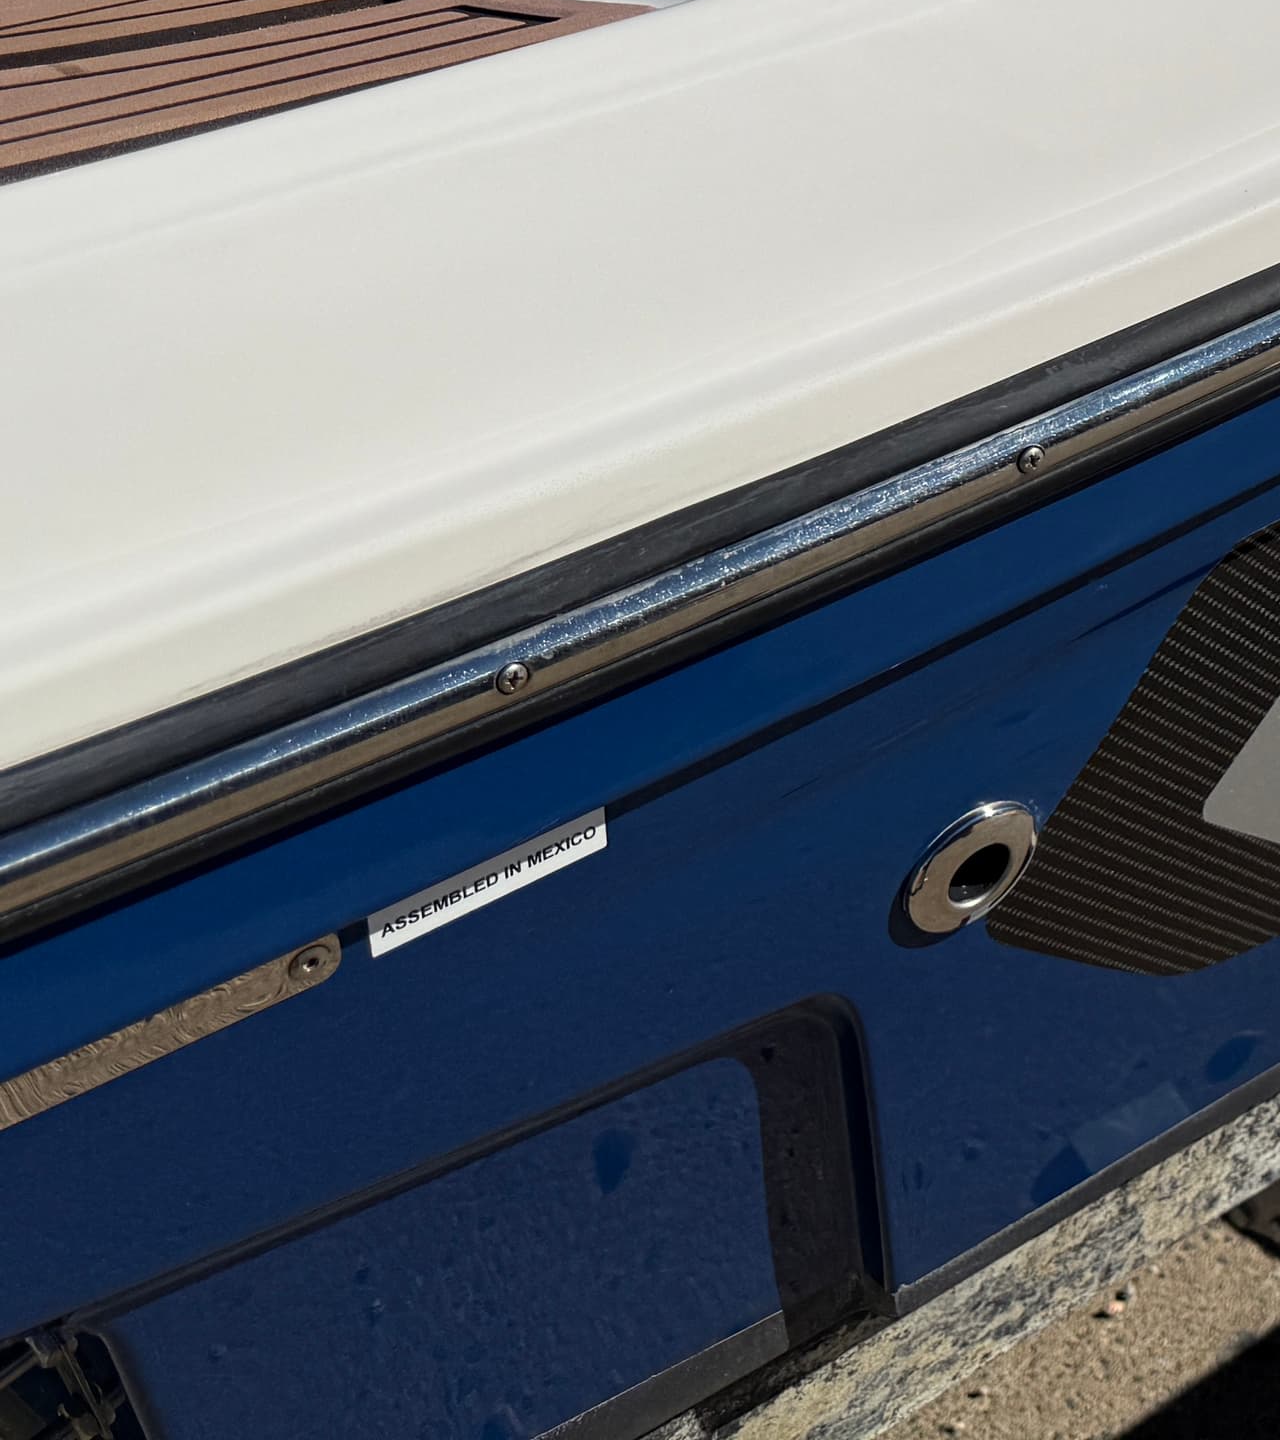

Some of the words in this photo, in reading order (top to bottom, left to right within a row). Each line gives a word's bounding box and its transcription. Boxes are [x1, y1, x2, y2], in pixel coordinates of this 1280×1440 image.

[381, 871, 499, 938] ASSEMBLED
[504, 860, 522, 879] IN
[527, 826, 597, 868] MEXICO
